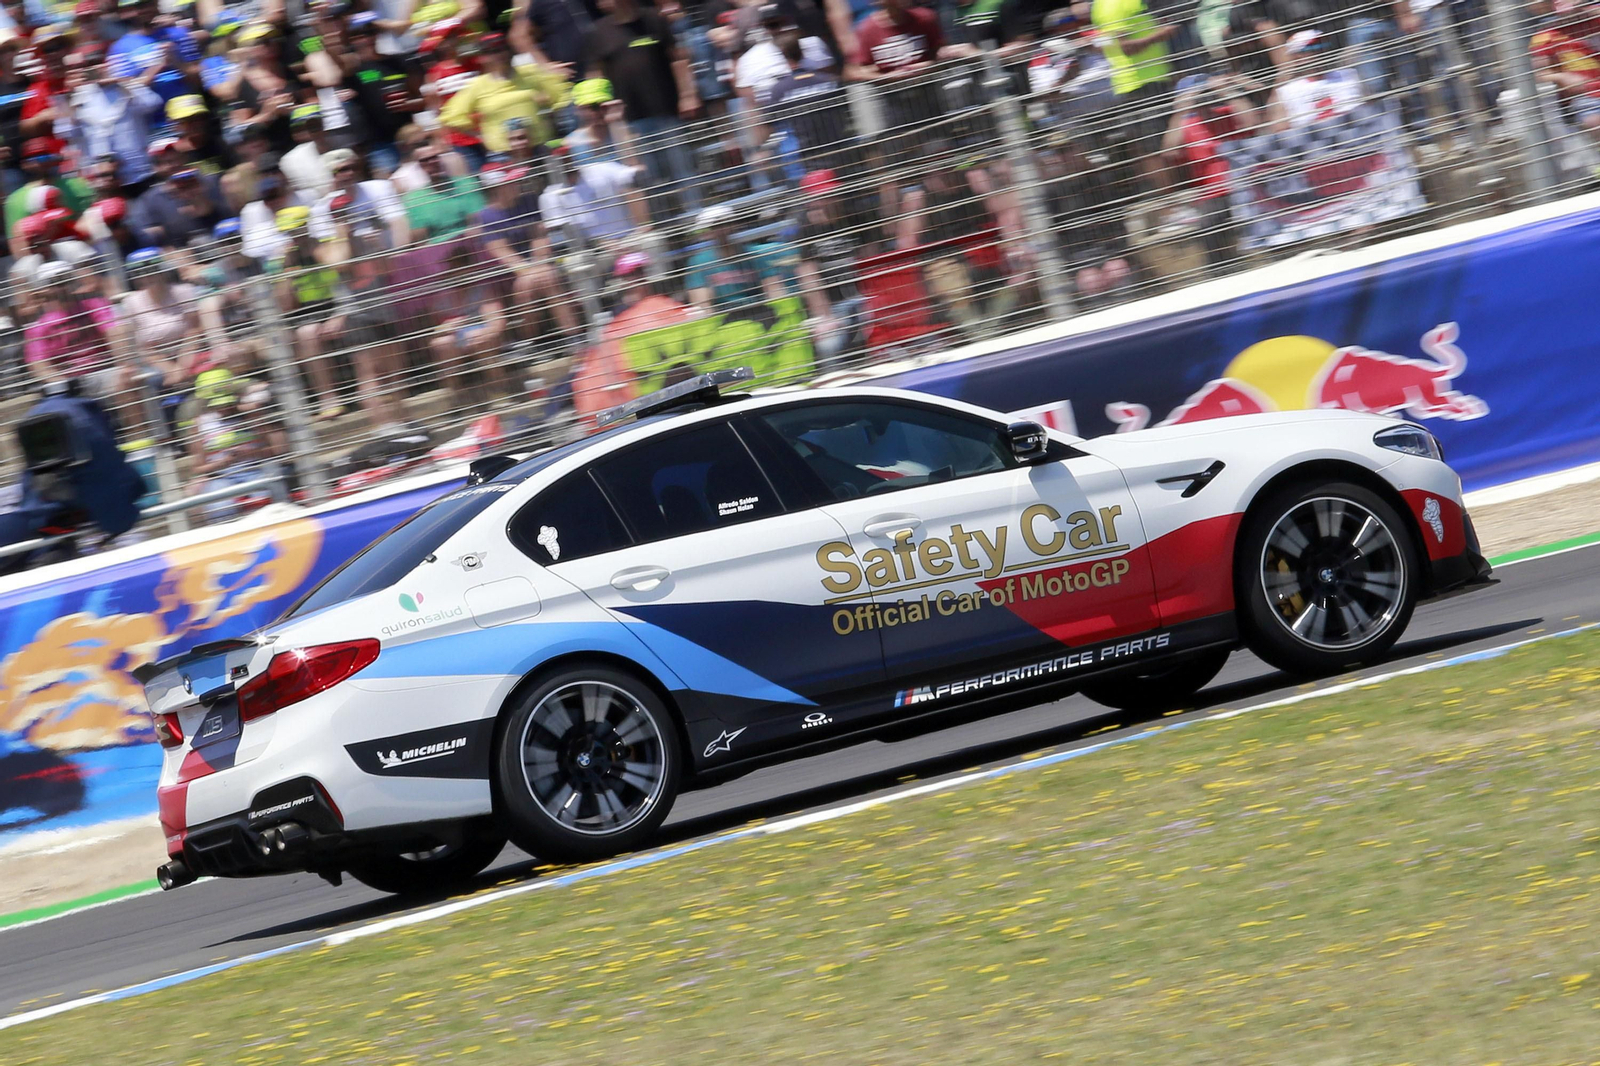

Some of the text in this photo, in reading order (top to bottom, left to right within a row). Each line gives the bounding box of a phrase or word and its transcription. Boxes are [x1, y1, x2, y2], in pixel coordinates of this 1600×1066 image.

[718, 501, 739, 509] Alfredo
[816, 503, 1122, 594] Safety Car
[832, 558, 1130, 636] Official Car of MotoGP
[381, 605, 463, 637] quironsalud
[936, 651, 1093, 699] PERFORMANCE
[1100, 632, 1170, 661] PARTS
[203, 715, 223, 738] M5
[402, 737, 467, 760] MICHELIN
